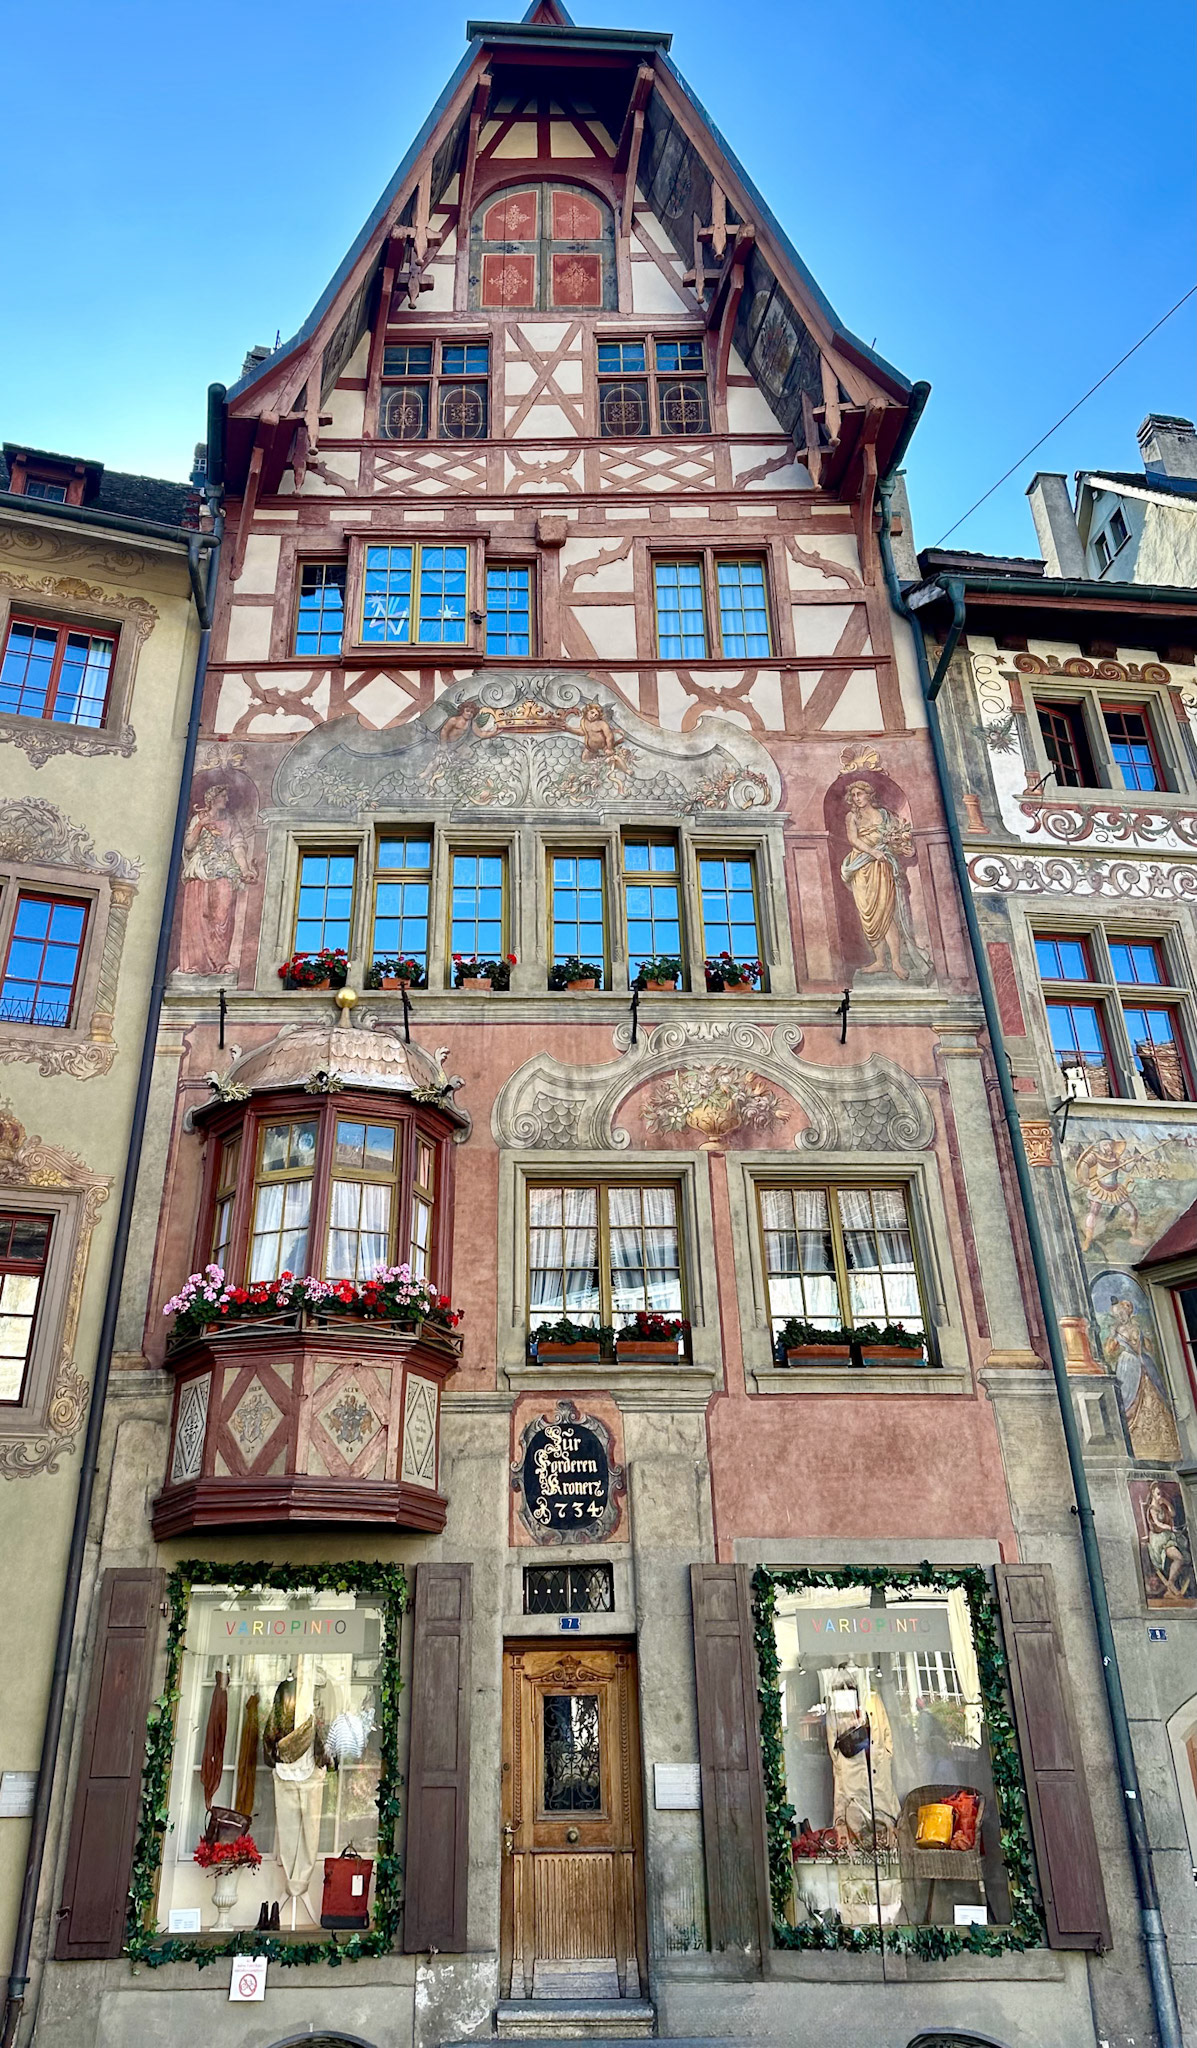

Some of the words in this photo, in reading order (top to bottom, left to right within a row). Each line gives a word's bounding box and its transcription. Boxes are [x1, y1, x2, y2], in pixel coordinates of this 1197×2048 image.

[533, 1496, 604, 1525] 1734
[225, 1619, 347, 1636] VARIOPINTO
[567, 1618, 573, 1628] 7
[811, 1617, 931, 1633] VARIOPINTO
[1155, 1629, 1161, 1639] 9
